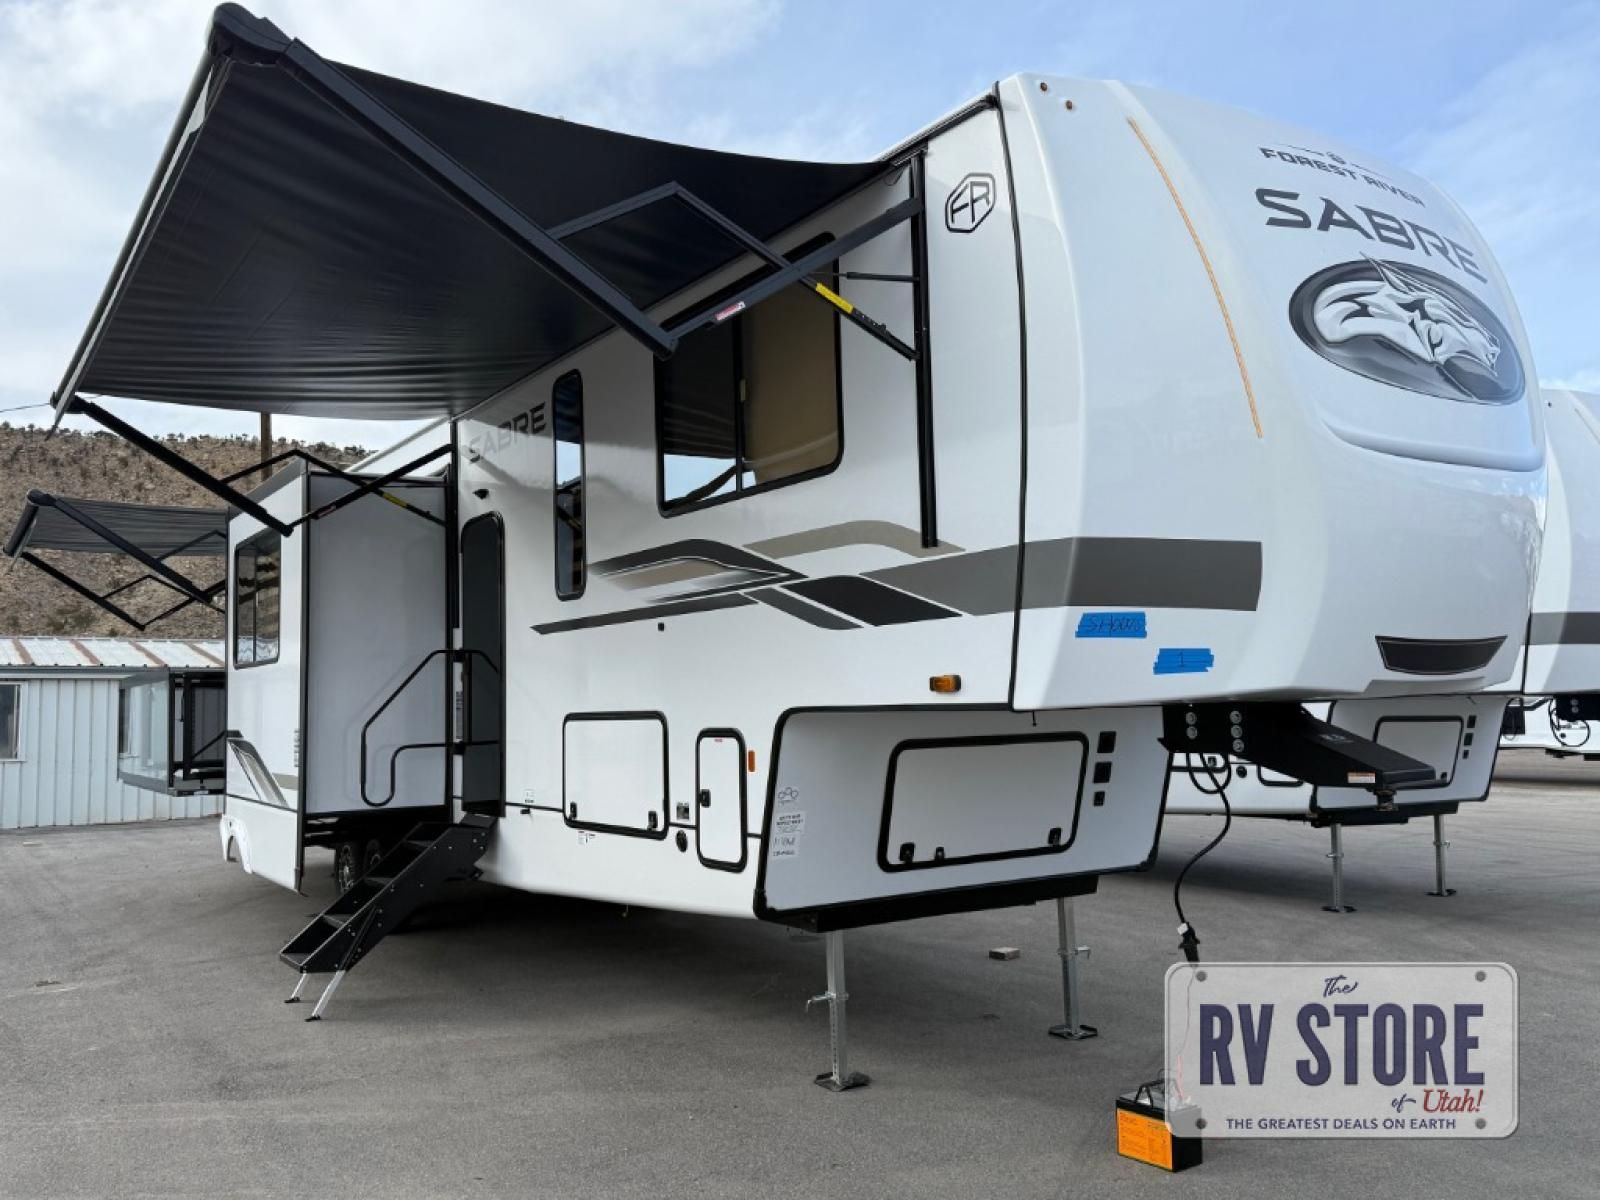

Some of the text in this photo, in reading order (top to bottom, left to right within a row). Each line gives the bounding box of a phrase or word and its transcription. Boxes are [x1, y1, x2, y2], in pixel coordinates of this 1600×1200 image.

[1258, 147, 1357, 180] FOREST
[1254, 187, 1488, 284] SABRE
[469, 401, 547, 463] SABRE
